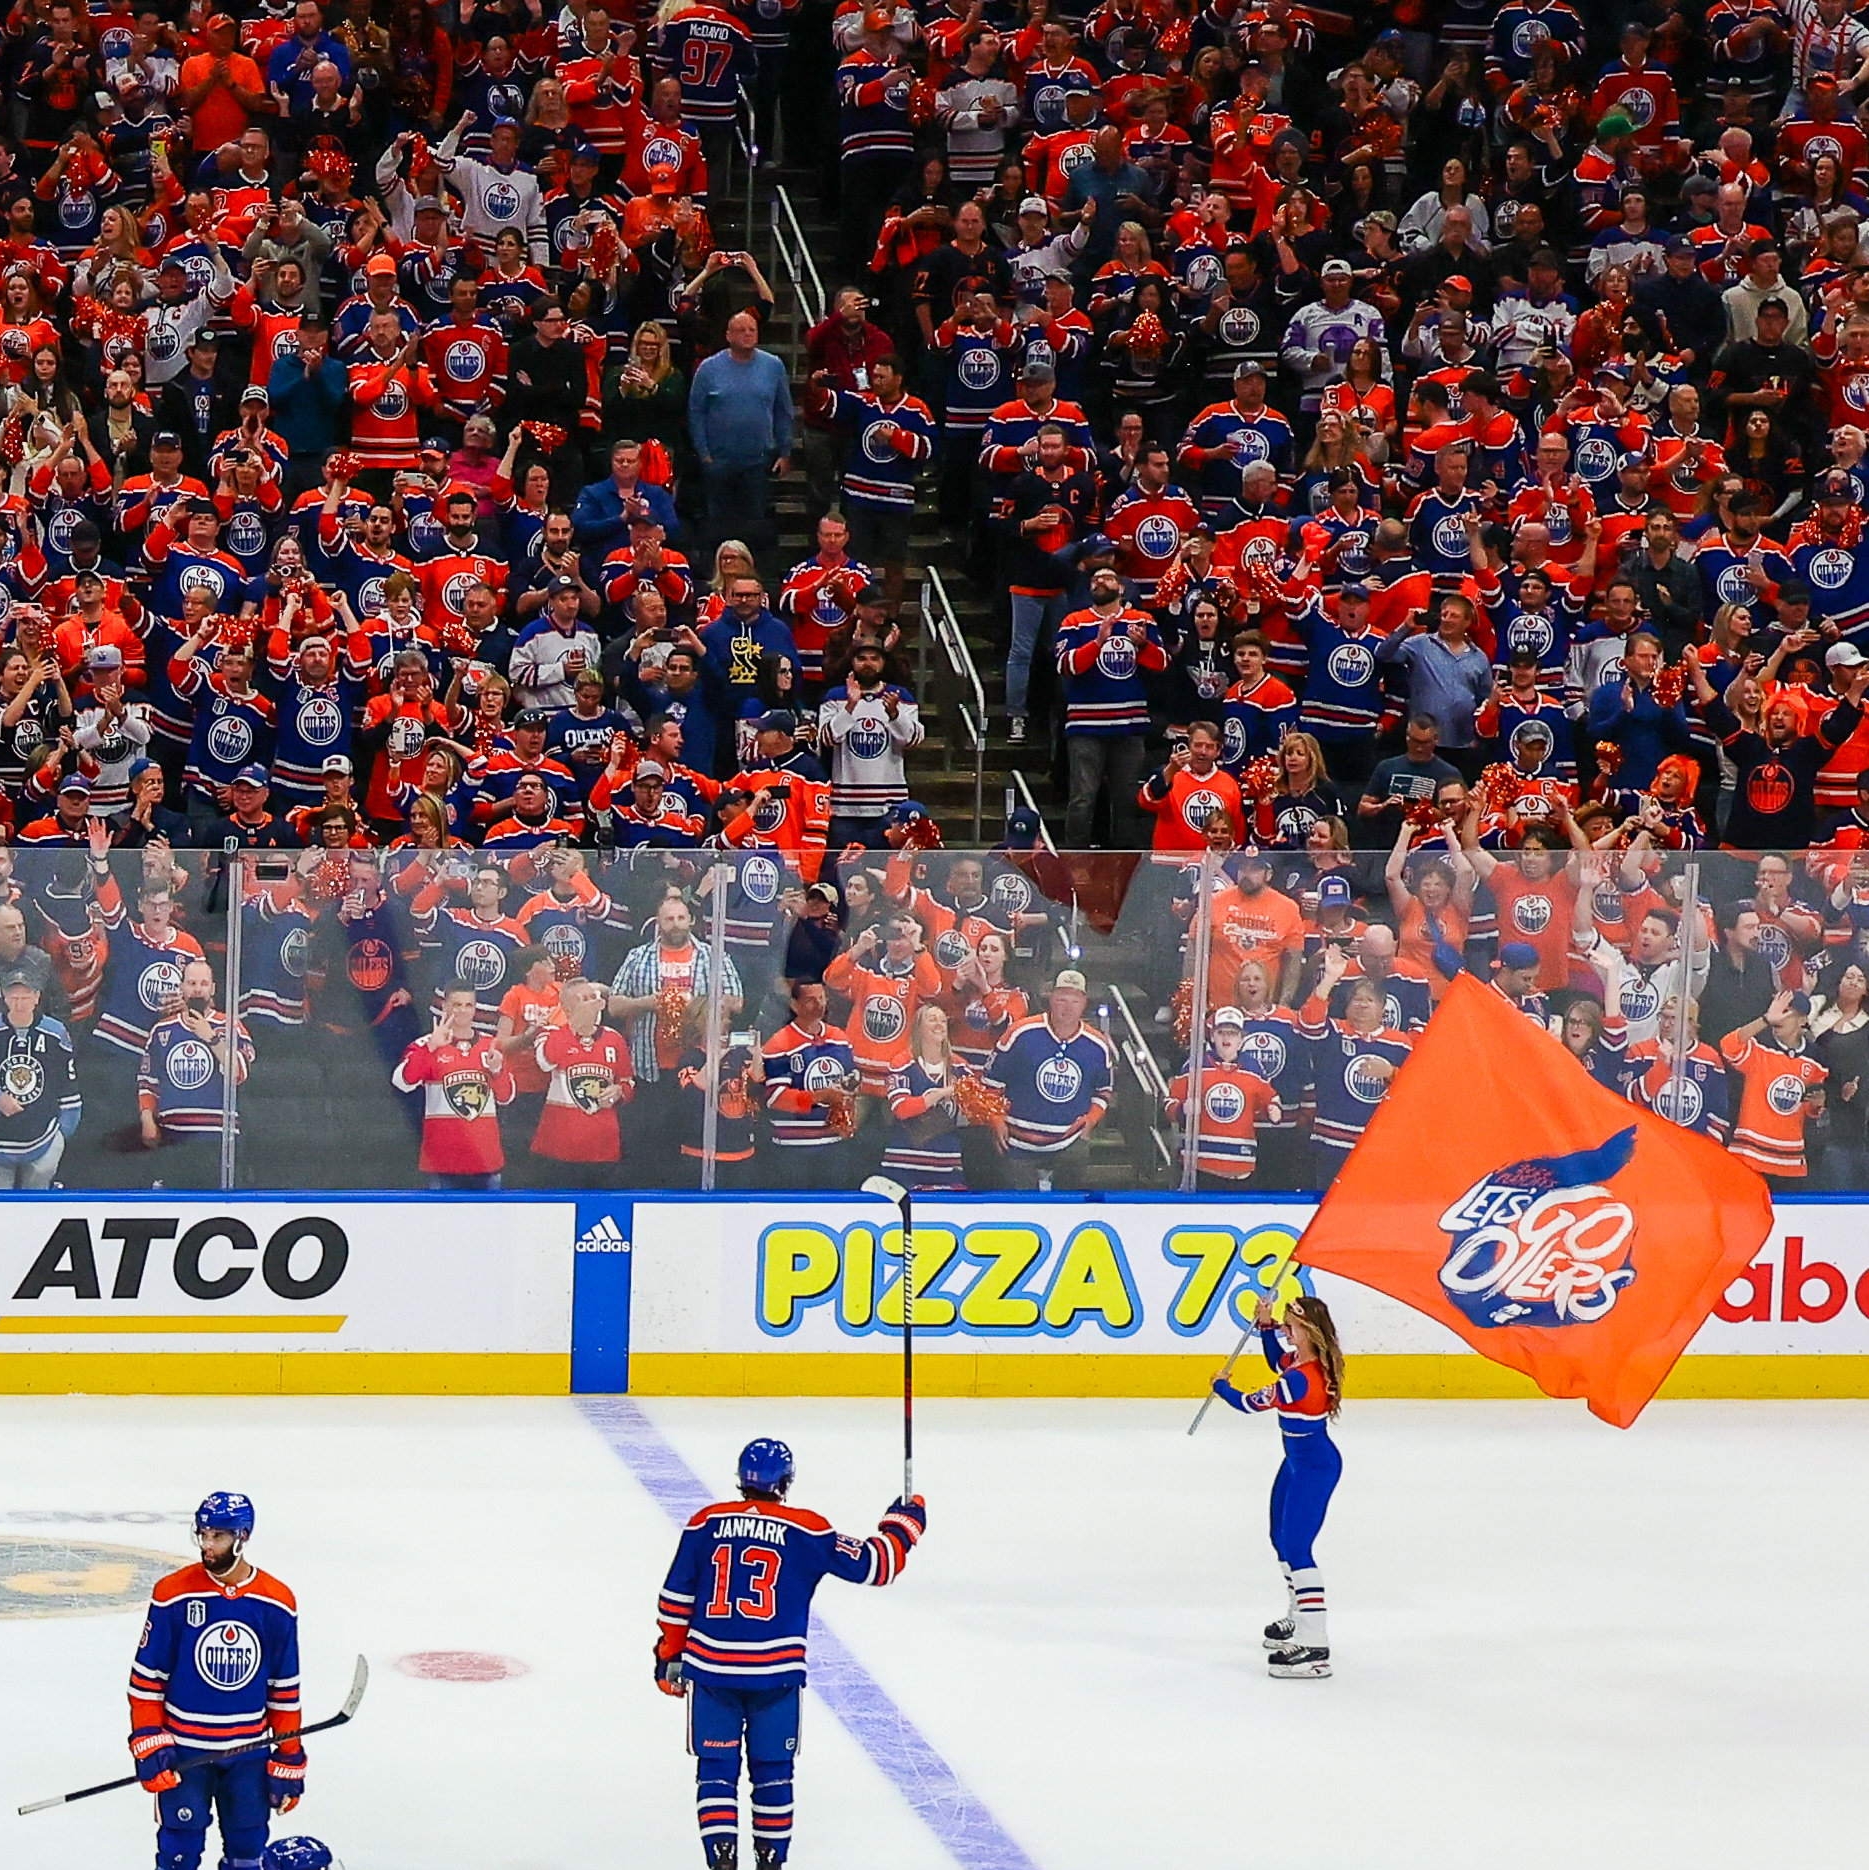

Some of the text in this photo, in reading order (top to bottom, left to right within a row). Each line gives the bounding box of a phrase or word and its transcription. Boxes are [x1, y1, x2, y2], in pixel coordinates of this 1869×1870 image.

[690, 25, 728, 41] McDAVID
[681, 40, 733, 86] 97
[1101, 650, 1135, 664] OILERS
[215, 730, 246, 749] OILERS
[850, 731, 884, 745] OILERS
[461, 957, 498, 973] OILERS
[1622, 992, 1654, 1006] OILERS
[867, 1011, 900, 1025] OILERS
[35, 1035, 46, 1053] A
[1694, 1064, 1707, 1081] C
[1801, 1062, 1811, 1077] C
[1439, 1174, 1634, 1265] LET'S GO
[576, 1238, 632, 1253] adidas
[11, 1215, 349, 1300] ATCO
[761, 1226, 1308, 1332] PIZZA 73
[1438, 1225, 1636, 1322] OILERS
[712, 1516, 788, 1547] JANMARK
[704, 1543, 784, 1622] 13
[204, 1647, 253, 1668] OILERS
